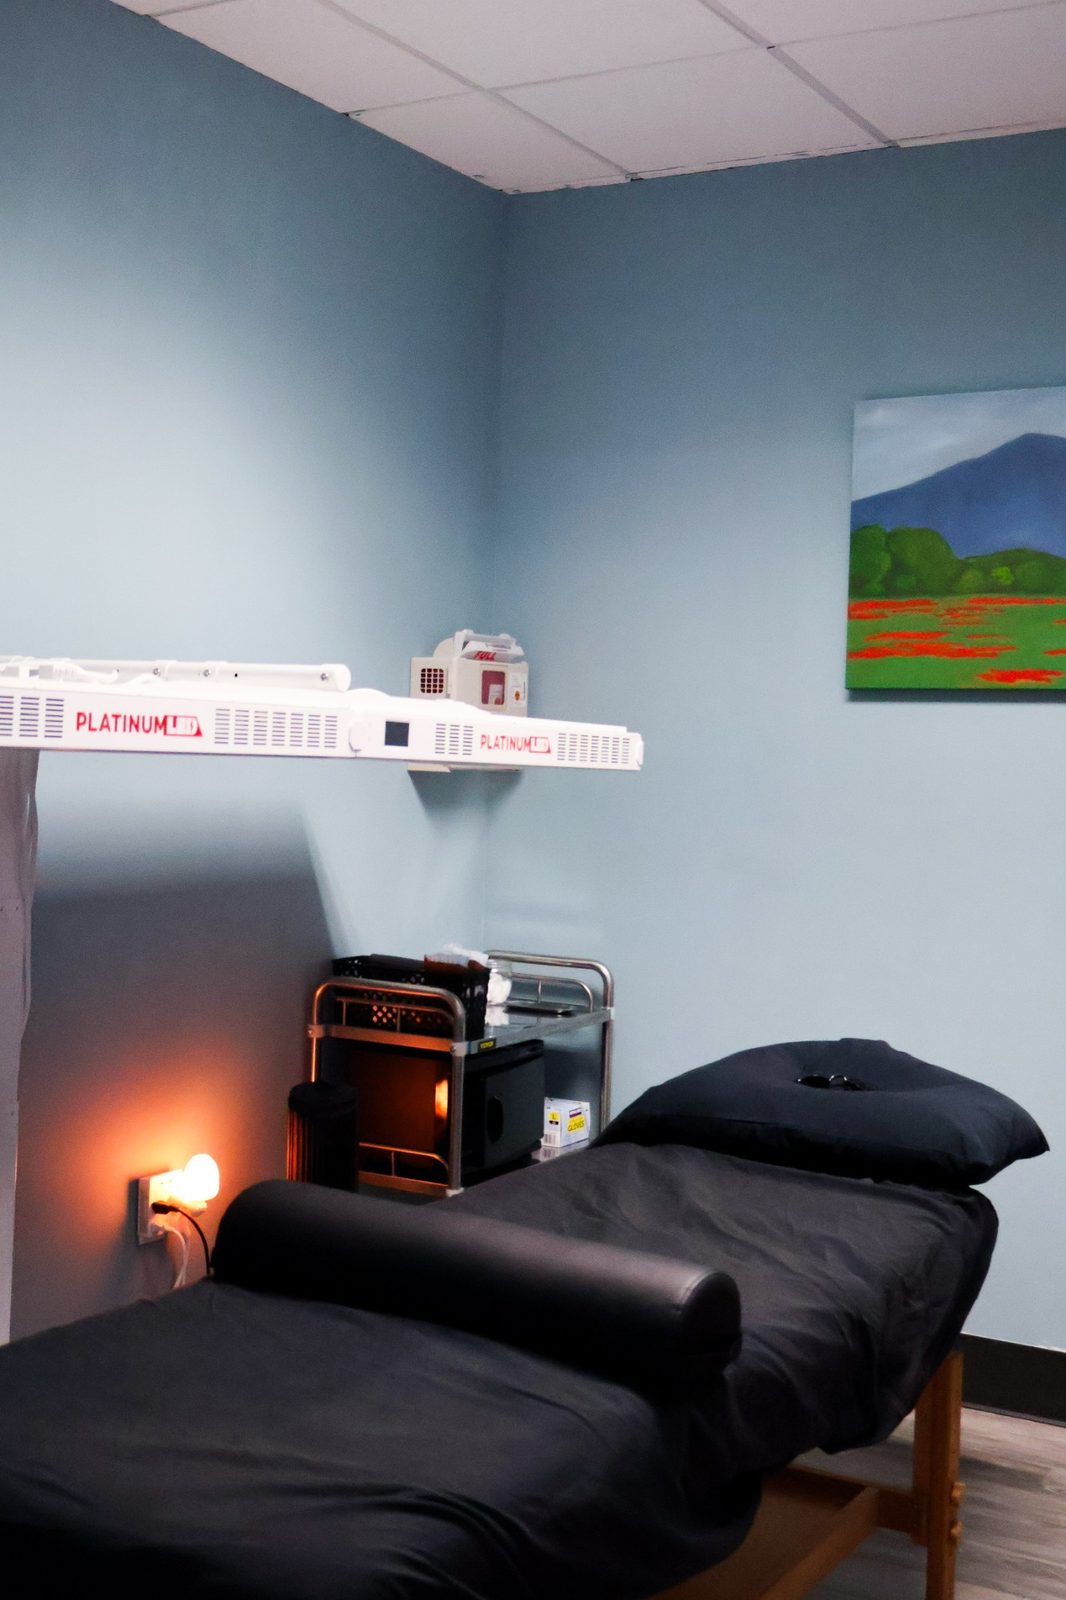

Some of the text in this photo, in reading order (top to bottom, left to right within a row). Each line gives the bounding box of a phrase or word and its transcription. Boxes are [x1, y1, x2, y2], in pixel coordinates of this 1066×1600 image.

[474, 650, 497, 662] FULL
[76, 711, 167, 736] PLATINUM
[481, 734, 530, 754] PLATINUM
